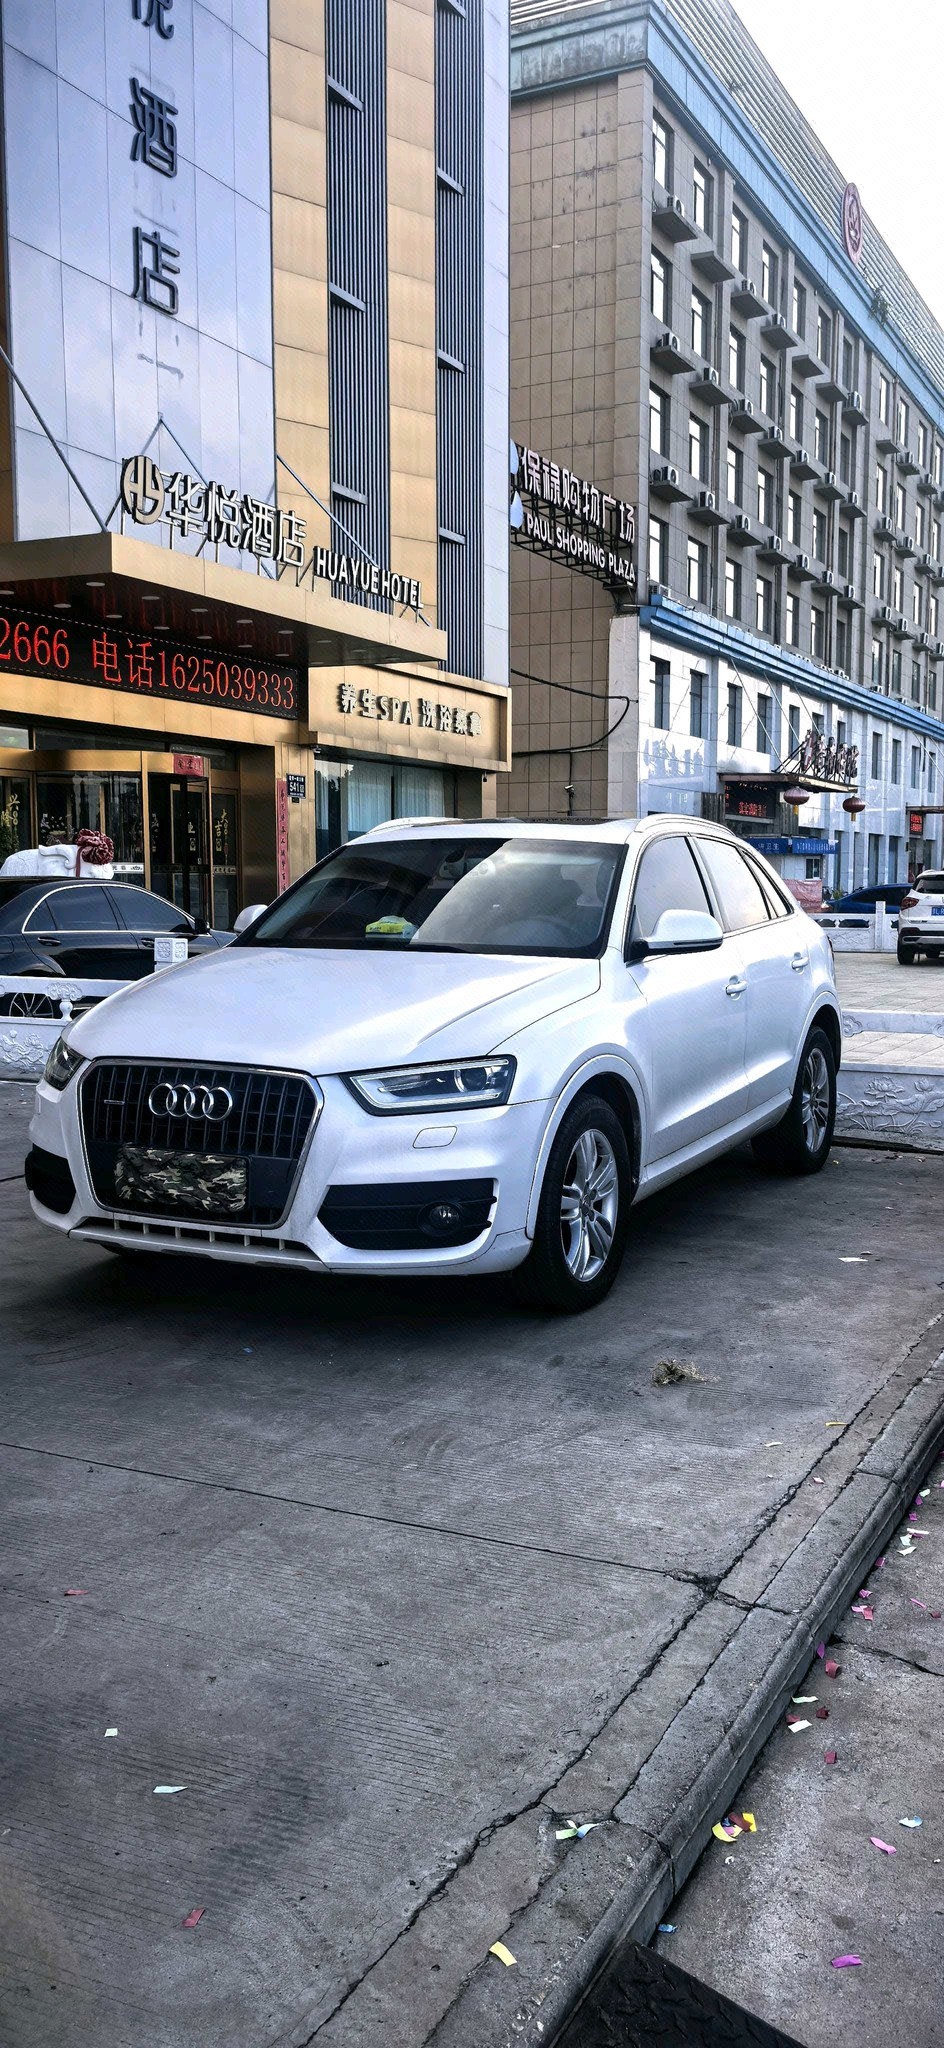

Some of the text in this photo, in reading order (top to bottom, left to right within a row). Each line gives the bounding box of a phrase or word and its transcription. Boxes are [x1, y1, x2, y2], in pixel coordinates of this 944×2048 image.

[165, 471, 308, 568] 华悦酒店
[526, 512, 636, 583] PAUL SHOPPING PLAZA
[314, 546, 425, 609] HUAYUE HOTEL
[0, 617, 70, 669] 2666
[339, 682, 414, 725] 养生SPA
